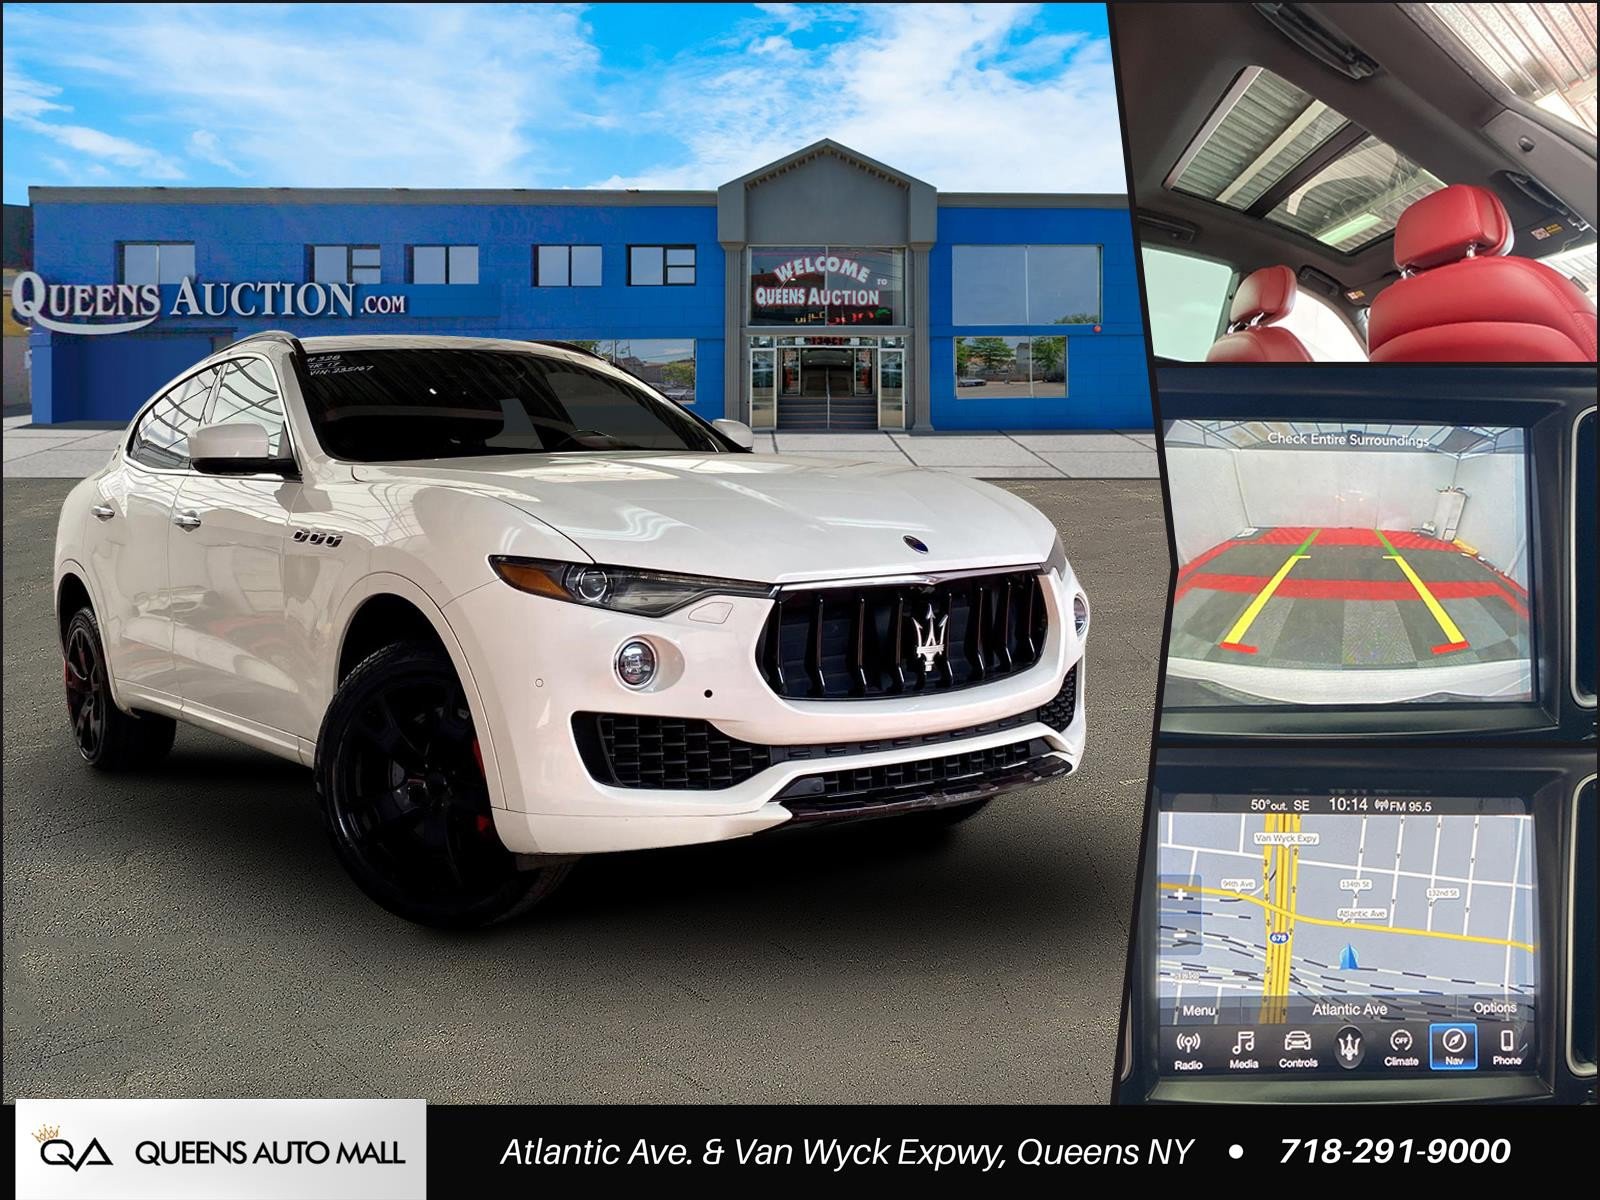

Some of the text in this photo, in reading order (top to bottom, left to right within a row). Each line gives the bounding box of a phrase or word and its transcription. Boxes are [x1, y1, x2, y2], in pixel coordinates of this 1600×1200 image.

[773, 255, 871, 284] WELCOME
[12, 271, 161, 334] QUEENS
[755, 287, 880, 306] QUEENS AUCTION
[1267, 432, 1430, 448] Check Entire Surroundings
[1294, 800, 1310, 811] SE
[1329, 798, 1368, 811] 10:14
[1390, 802, 1407, 811] FM
[1409, 802, 1432, 811] 95.5
[1256, 834, 1317, 845] Van Wyck Expy
[1361, 880, 1370, 888] St
[1428, 889, 1457, 898] 132nd St
[1339, 909, 1385, 918] Atlantic Ave
[1272, 934, 1287, 942] 678
[1183, 1004, 1216, 1017] Menu
[1312, 1002, 1388, 1016] Atlantic Ave
[1474, 1002, 1517, 1016] Options
[1175, 1059, 1202, 1071] Radio
[1229, 1058, 1259, 1069] Media
[1279, 1057, 1318, 1068] Controls
[1384, 1056, 1419, 1067] Climate
[1445, 1056, 1463, 1066] Nav
[1492, 1054, 1521, 1066] Phone
